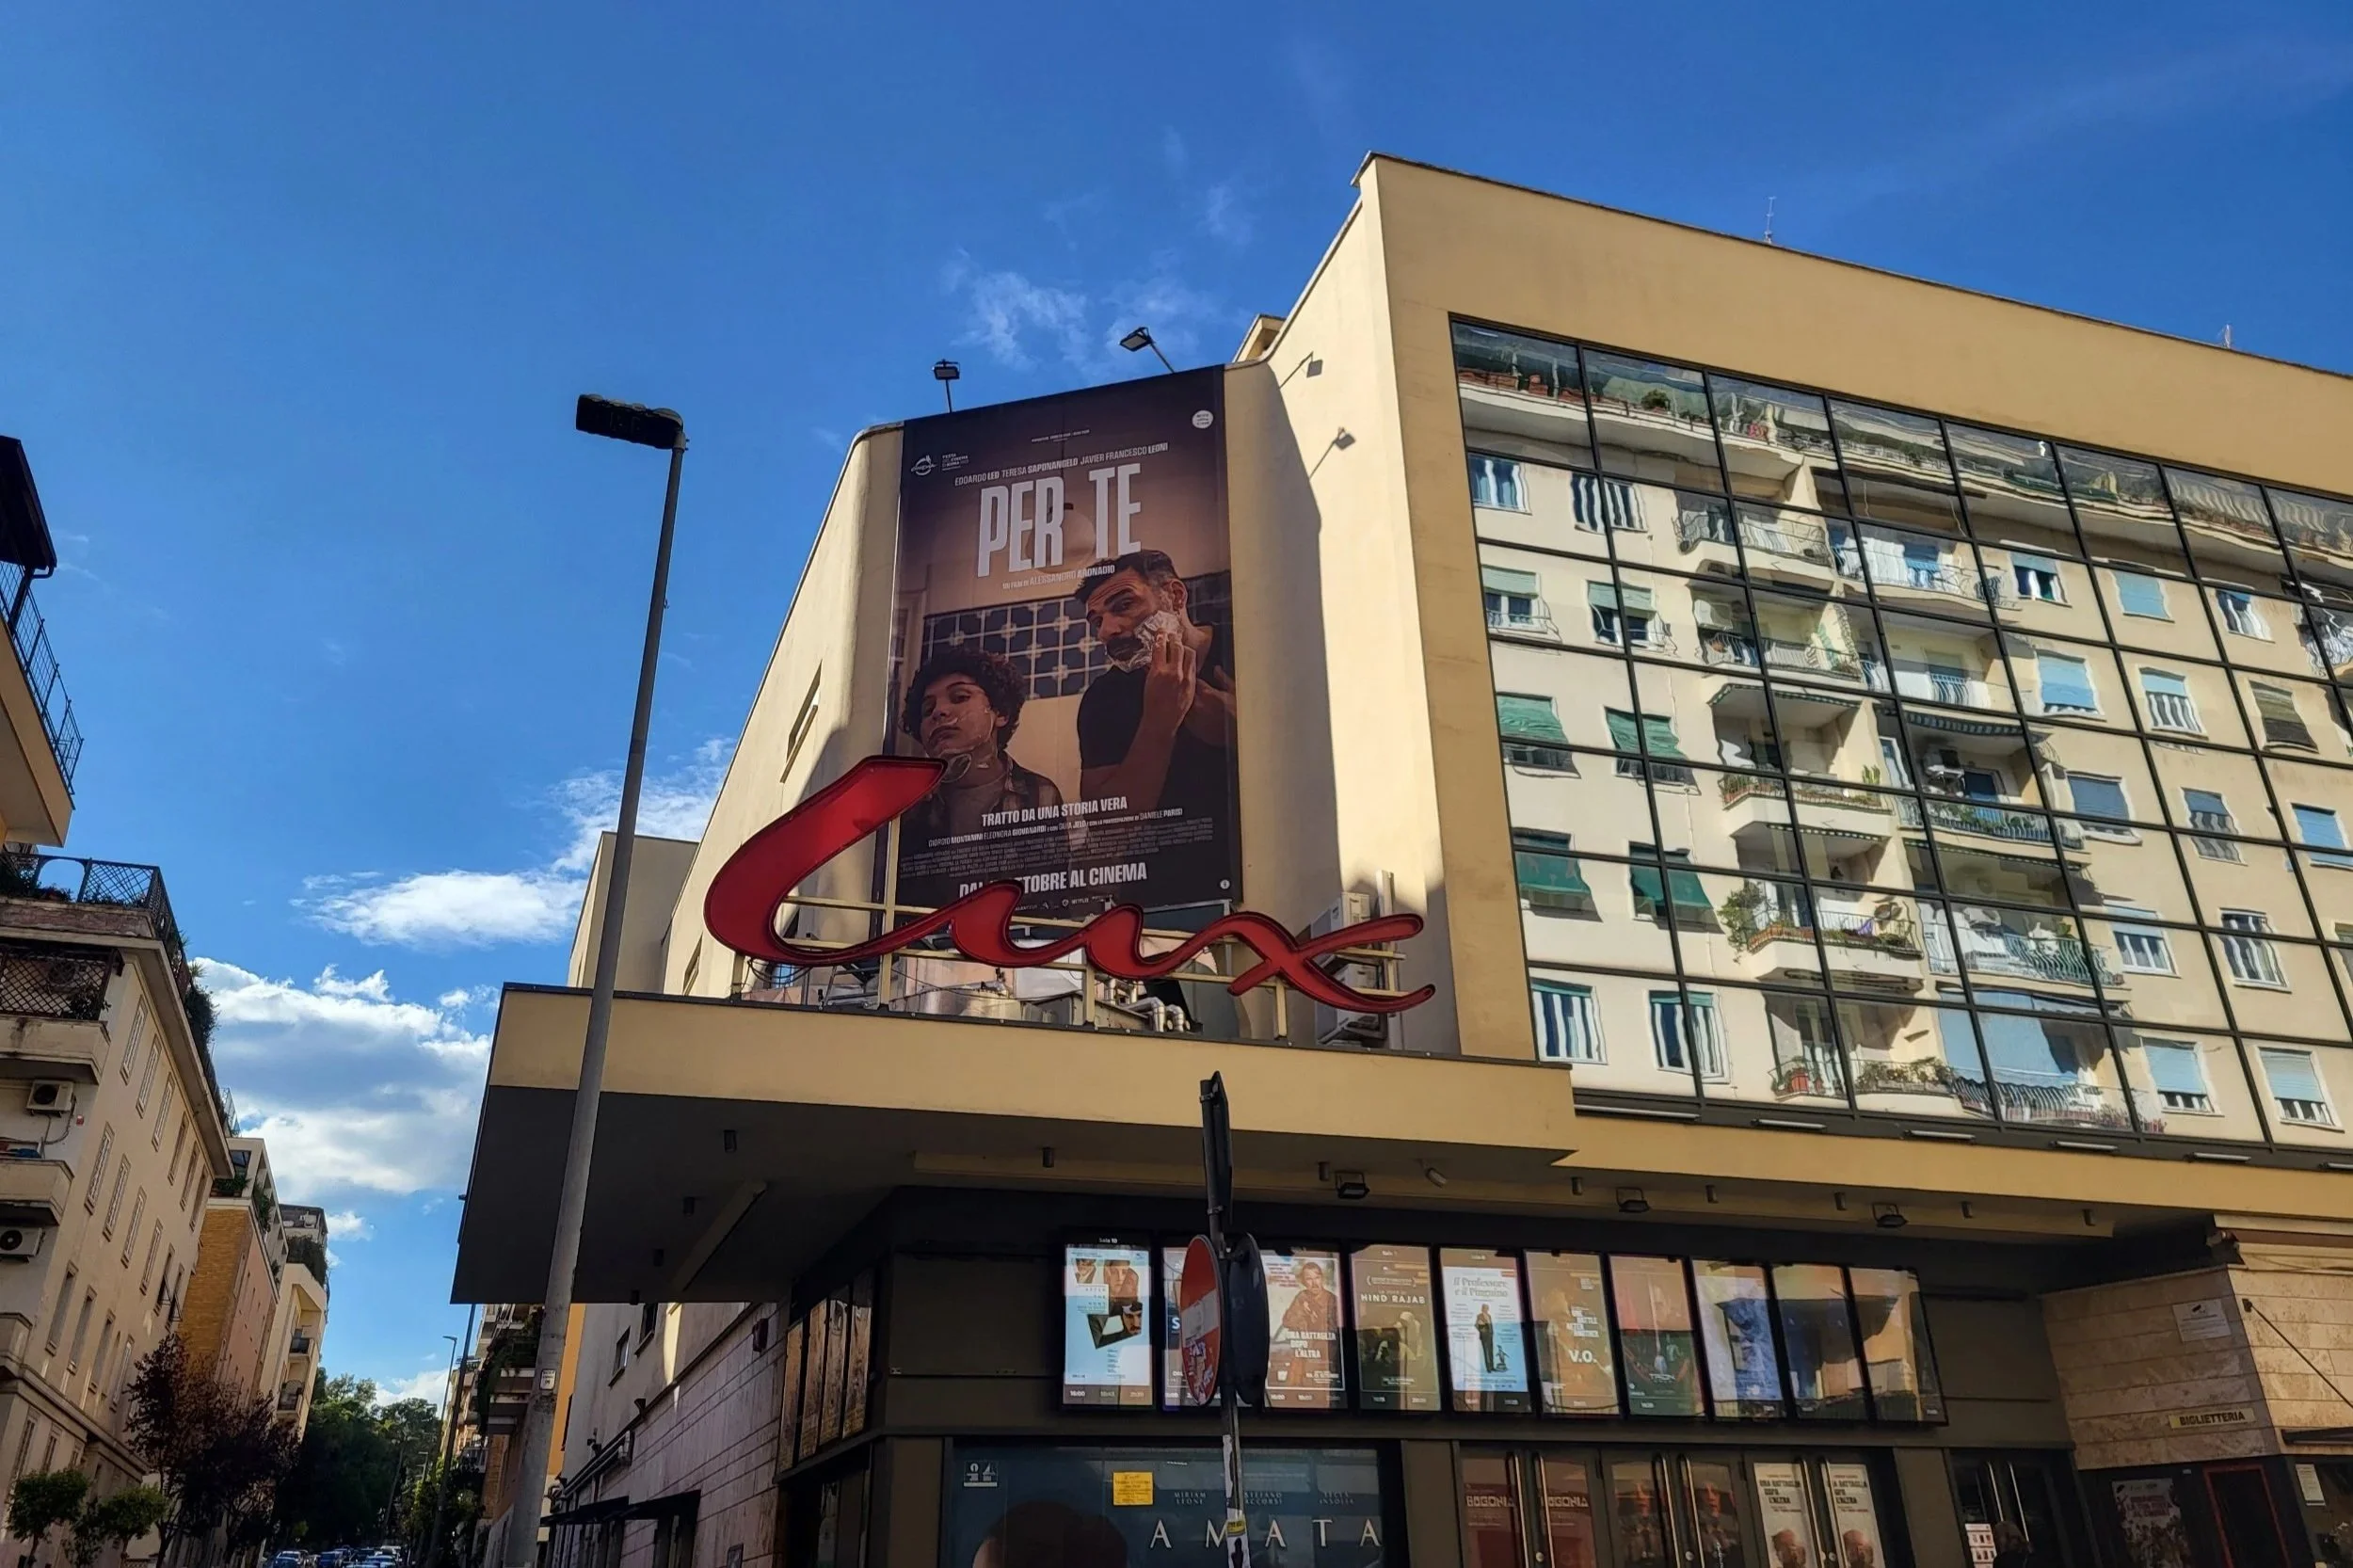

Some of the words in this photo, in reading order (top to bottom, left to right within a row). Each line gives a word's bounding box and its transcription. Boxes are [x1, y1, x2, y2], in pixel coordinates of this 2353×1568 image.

[954, 472, 986, 487] EDOARDO
[1001, 467, 1027, 478] TERESA
[1028, 457, 1078, 473] SAPONANGELO
[1080, 453, 1105, 465] JAVIER
[1105, 446, 1147, 461] FRANCESCO
[1147, 442, 1168, 454] LEONI
[977, 475, 1064, 578] PER
[1088, 462, 1142, 560] TE
[1030, 570, 1077, 585] ALESSANDRO
[982, 809, 1019, 827] TRATTO
[1021, 808, 1036, 823] DA
[1037, 805, 1060, 820] UNA
[1061, 800, 1098, 816] STORIA
[1100, 796, 1128, 811] VERA
[928, 837, 951, 847] GIORGIO
[951, 833, 984, 844] MONTANINI
[984, 829, 1012, 840] ELEONORA
[1012, 824, 1047, 837] GIOVANARDI
[1140, 809, 1163, 821] DANIELE
[1163, 808, 1183, 817] PARISI
[1069, 869, 1087, 888] AL
[1089, 862, 1147, 886] CINEMA
[1360, 1293, 1388, 1303] HIND
[1391, 1295, 1426, 1304] RAJAB
[1568, 1350, 1598, 1363] V.O.
[2180, 1411, 2246, 1426] BIGLIETTERIA
[1150, 1518, 1382, 1549] AMATA
